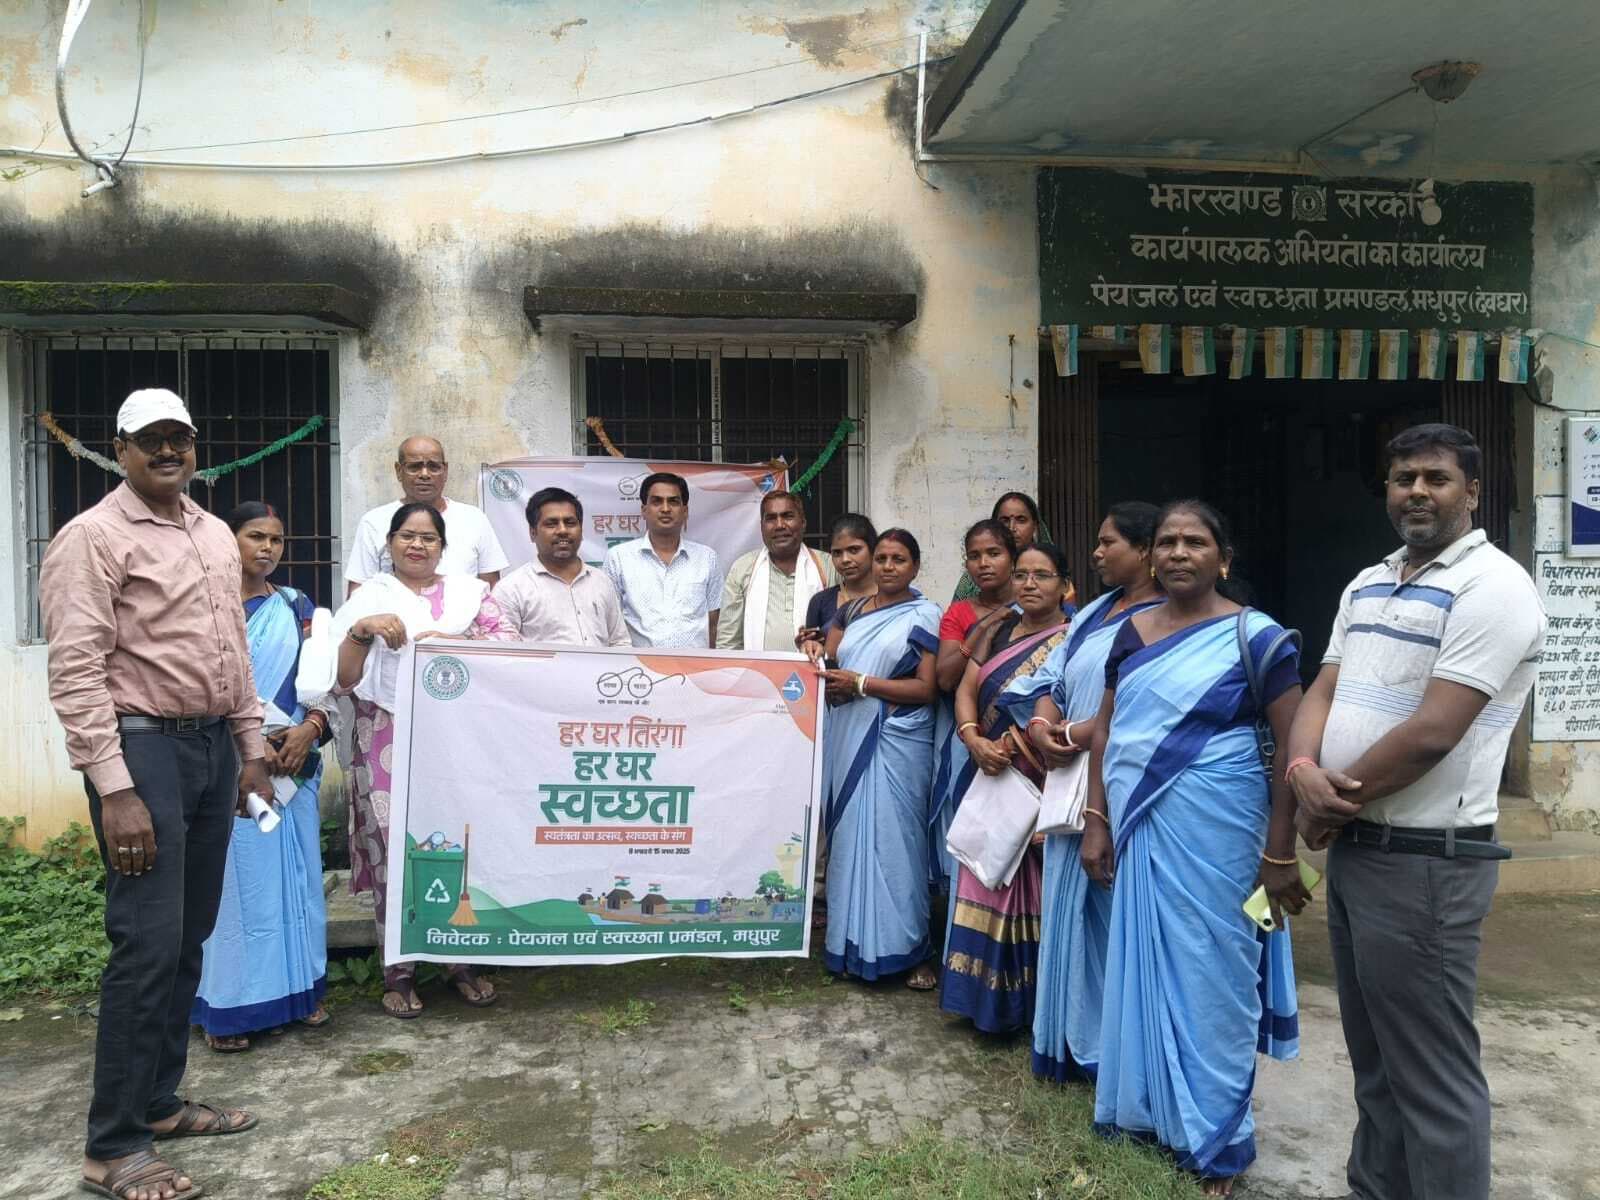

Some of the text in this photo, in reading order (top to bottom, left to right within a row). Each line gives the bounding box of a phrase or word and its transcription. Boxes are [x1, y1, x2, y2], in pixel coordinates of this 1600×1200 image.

[1129, 226, 1487, 271] कार्यपालक अभियंता का कार्यालय
[1183, 279, 1218, 308] एवं
[1223, 287, 1318, 312] स्वच्छता
[592, 515, 640, 533] हर घर
[558, 715, 687, 748] हर घर तिरंगा
[572, 751, 656, 781] हर घर
[538, 784, 695, 824] स्वच्छता
[582, 830, 595, 841] का
[426, 928, 491, 945] निवेदक
[508, 929, 568, 946] पेयजल
[573, 929, 599, 945] एवं
[602, 931, 664, 945] स्वच्छता
[733, 929, 781, 946] मधुपुर
